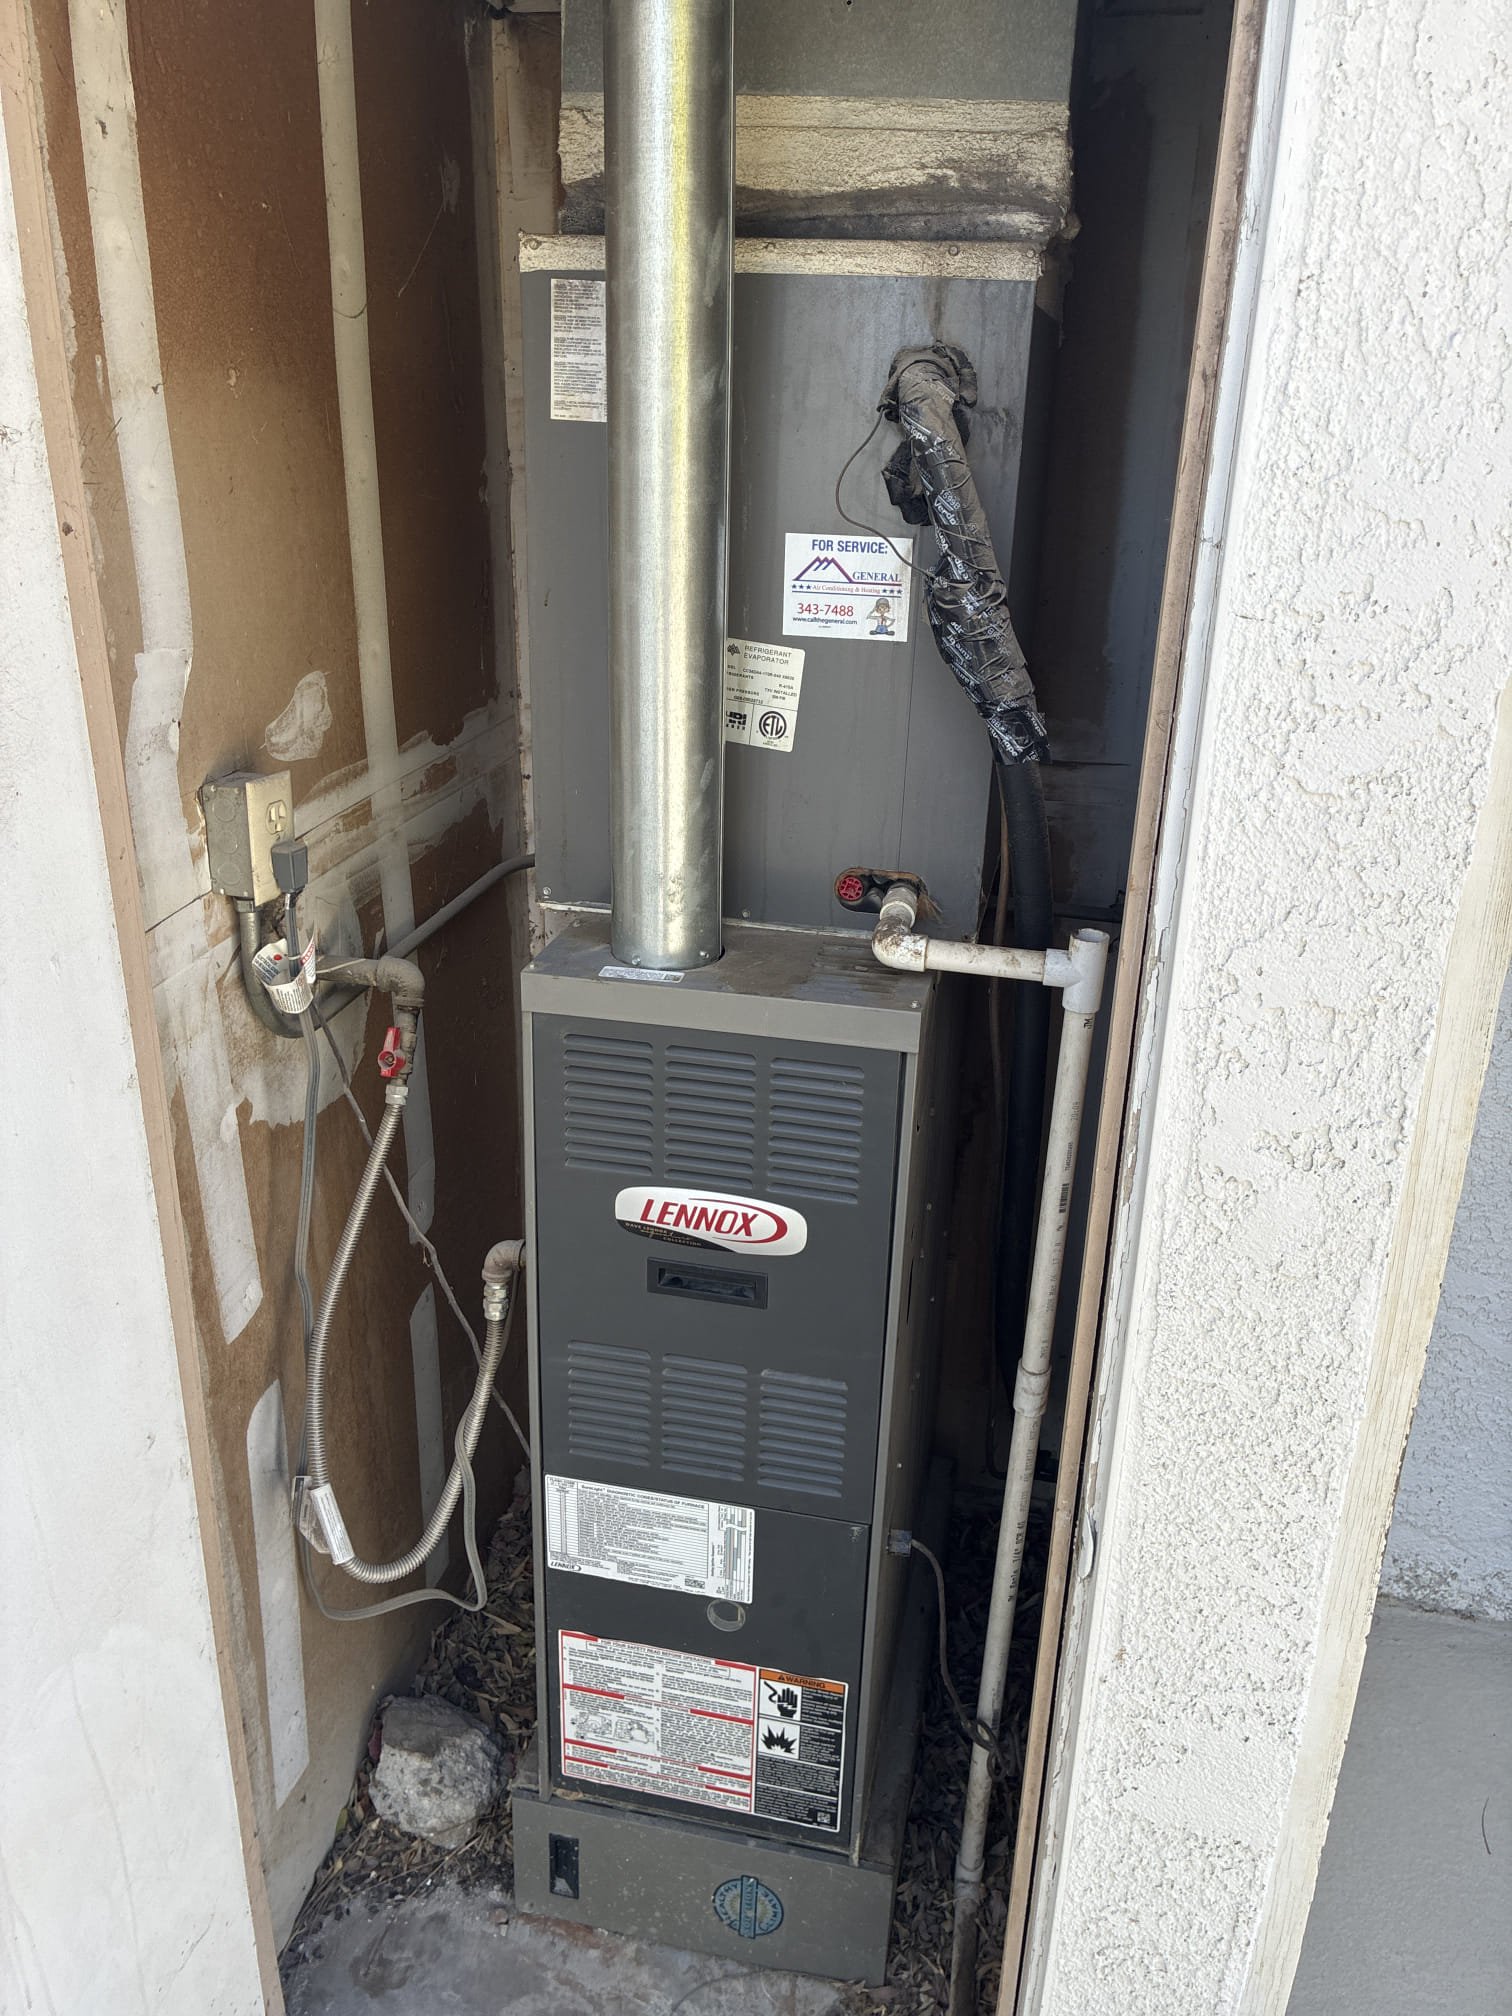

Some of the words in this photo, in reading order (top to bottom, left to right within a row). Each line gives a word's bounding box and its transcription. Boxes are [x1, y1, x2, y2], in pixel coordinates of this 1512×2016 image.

[812, 539, 833, 552] FOR
[837, 540, 888, 554] SERVICE:
[852, 571, 901, 582] GENERAL
[797, 602, 854, 617] 343-7488
[743, 652, 789, 665] EVAPORATOR
[744, 645, 792, 658] REFRIGERANT
[762, 715, 783, 737] ETL
[640, 1199, 758, 1237] LENNOX
[600, 1639, 611, 1647] FOR
[612, 1641, 626, 1649] YOUR
[627, 1643, 646, 1651] SAFETY
[647, 1647, 661, 1655] READ
[786, 1675, 826, 1688] WARNING
